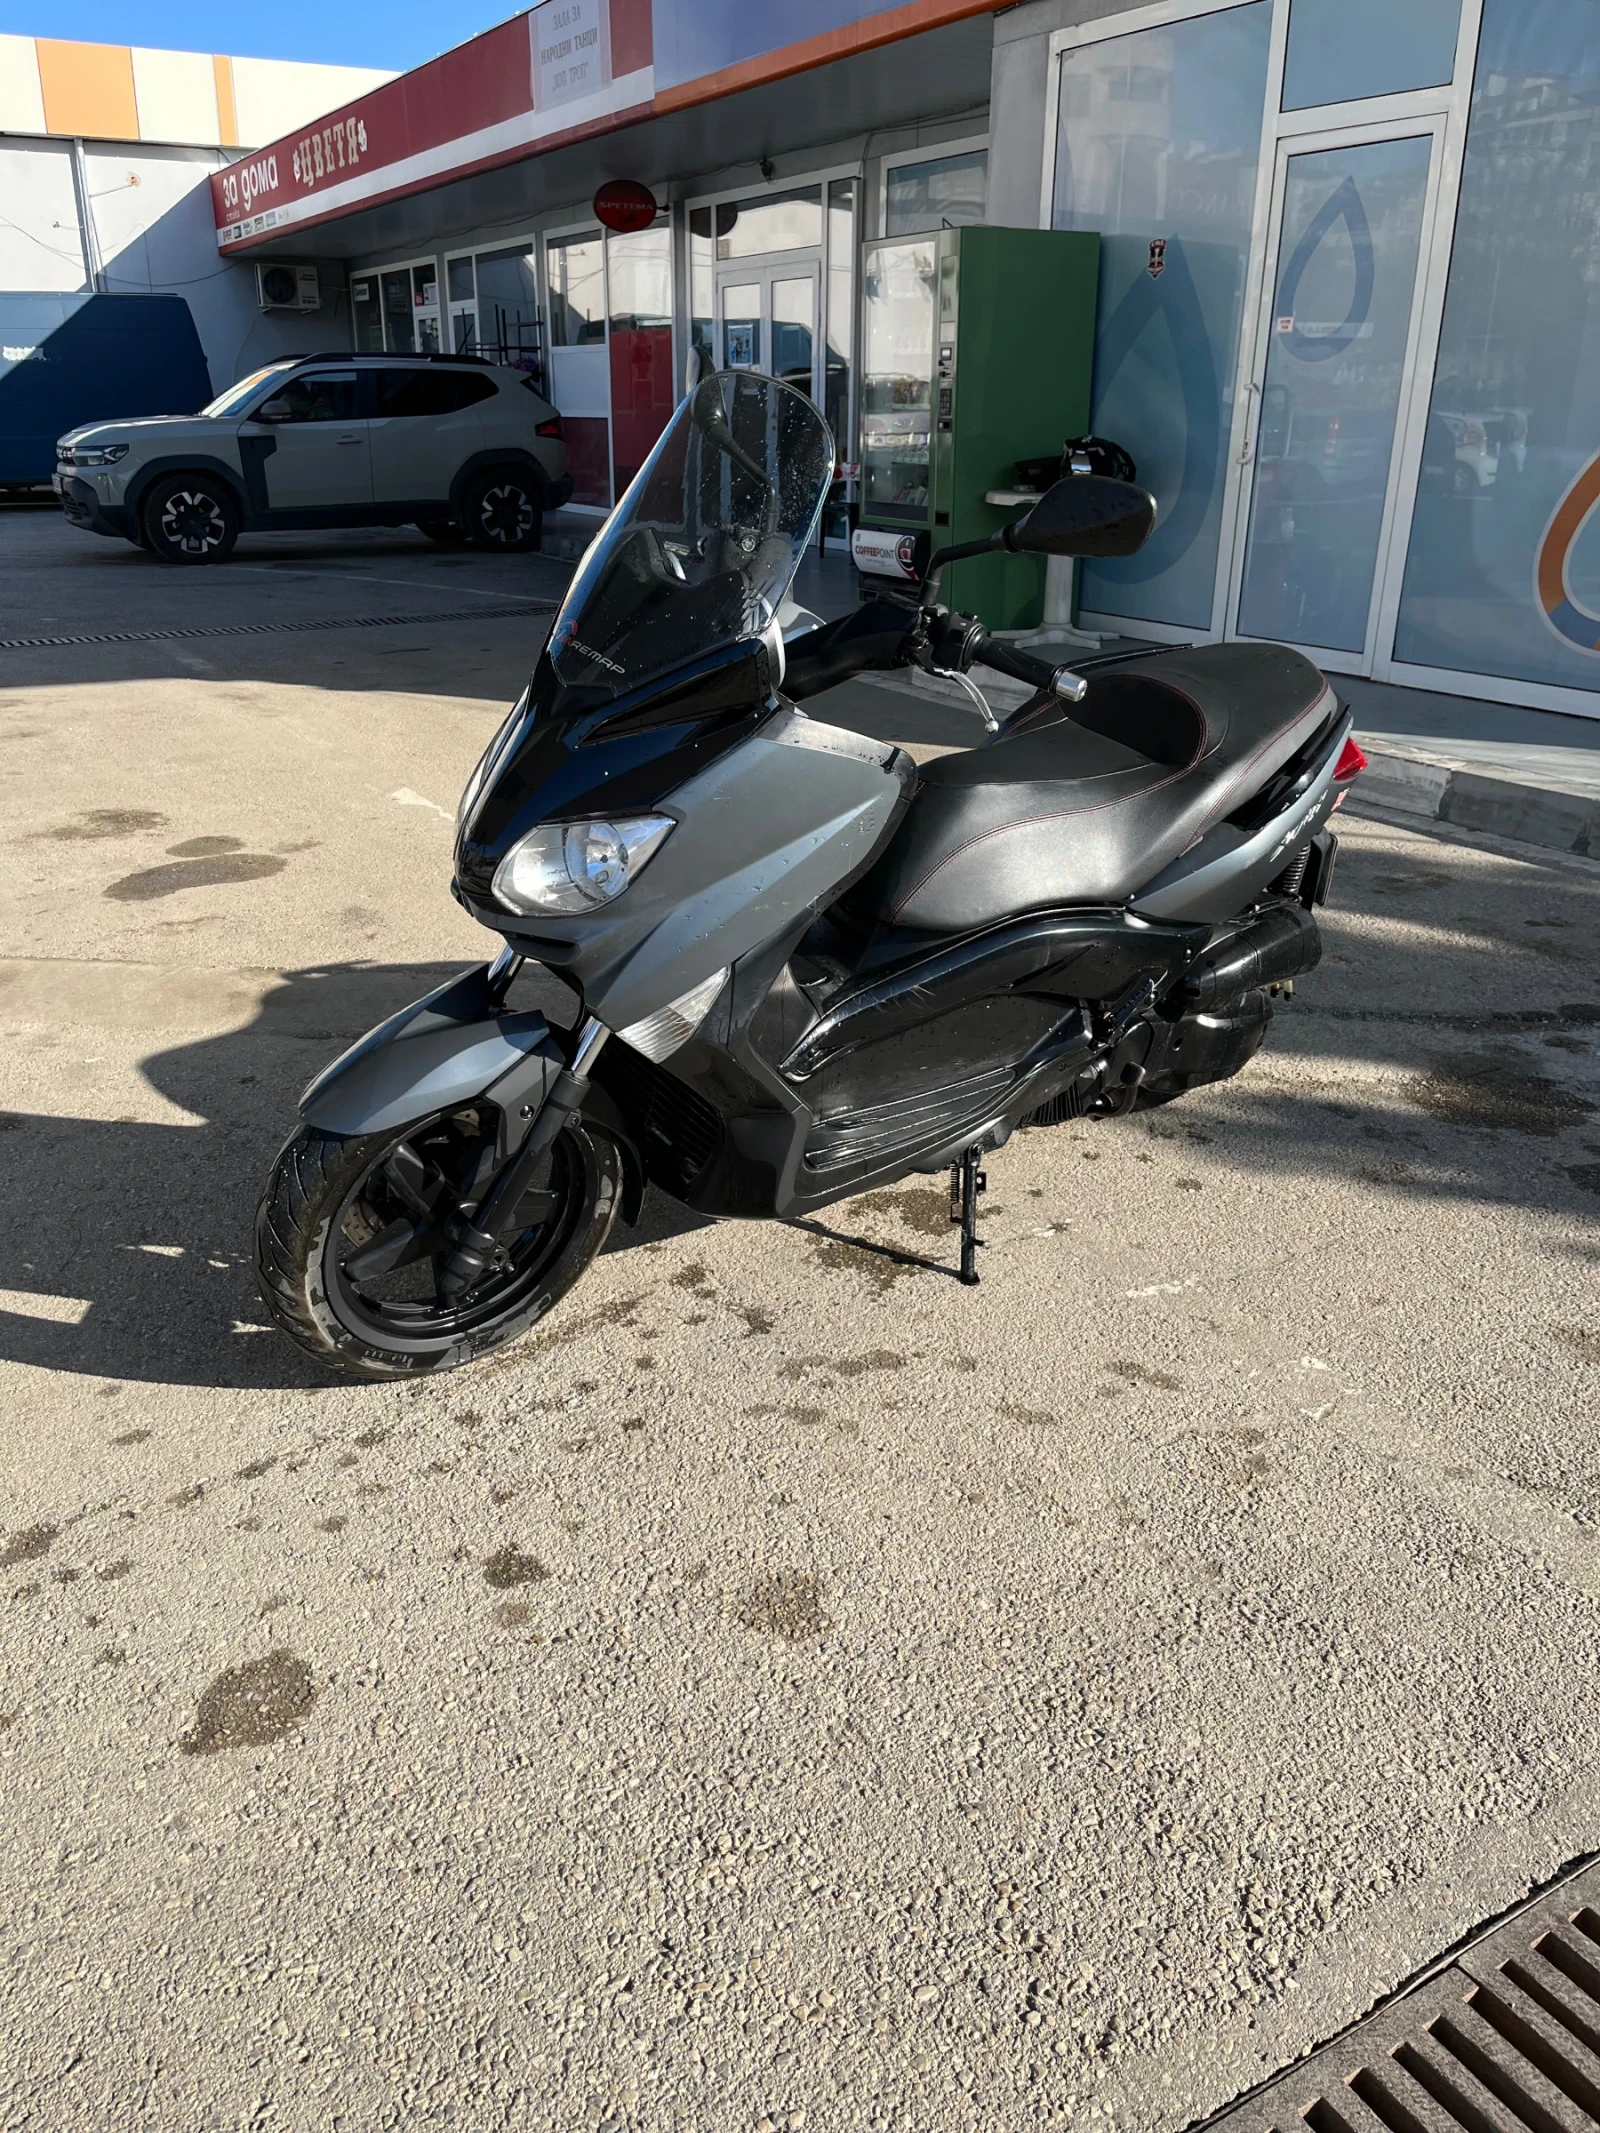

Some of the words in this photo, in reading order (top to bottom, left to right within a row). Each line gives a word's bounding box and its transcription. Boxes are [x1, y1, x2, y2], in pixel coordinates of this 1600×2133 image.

[553, 10, 570, 30] ЗАЛА
[572, 4, 582, 21] ЗА
[541, 38, 572, 65] НАРОДНИ
[574, 27, 598, 51] ТАНЦИ
[299, 117, 359, 188] ЦВЕТЯ
[600, 201, 654, 210] SPETEMA
